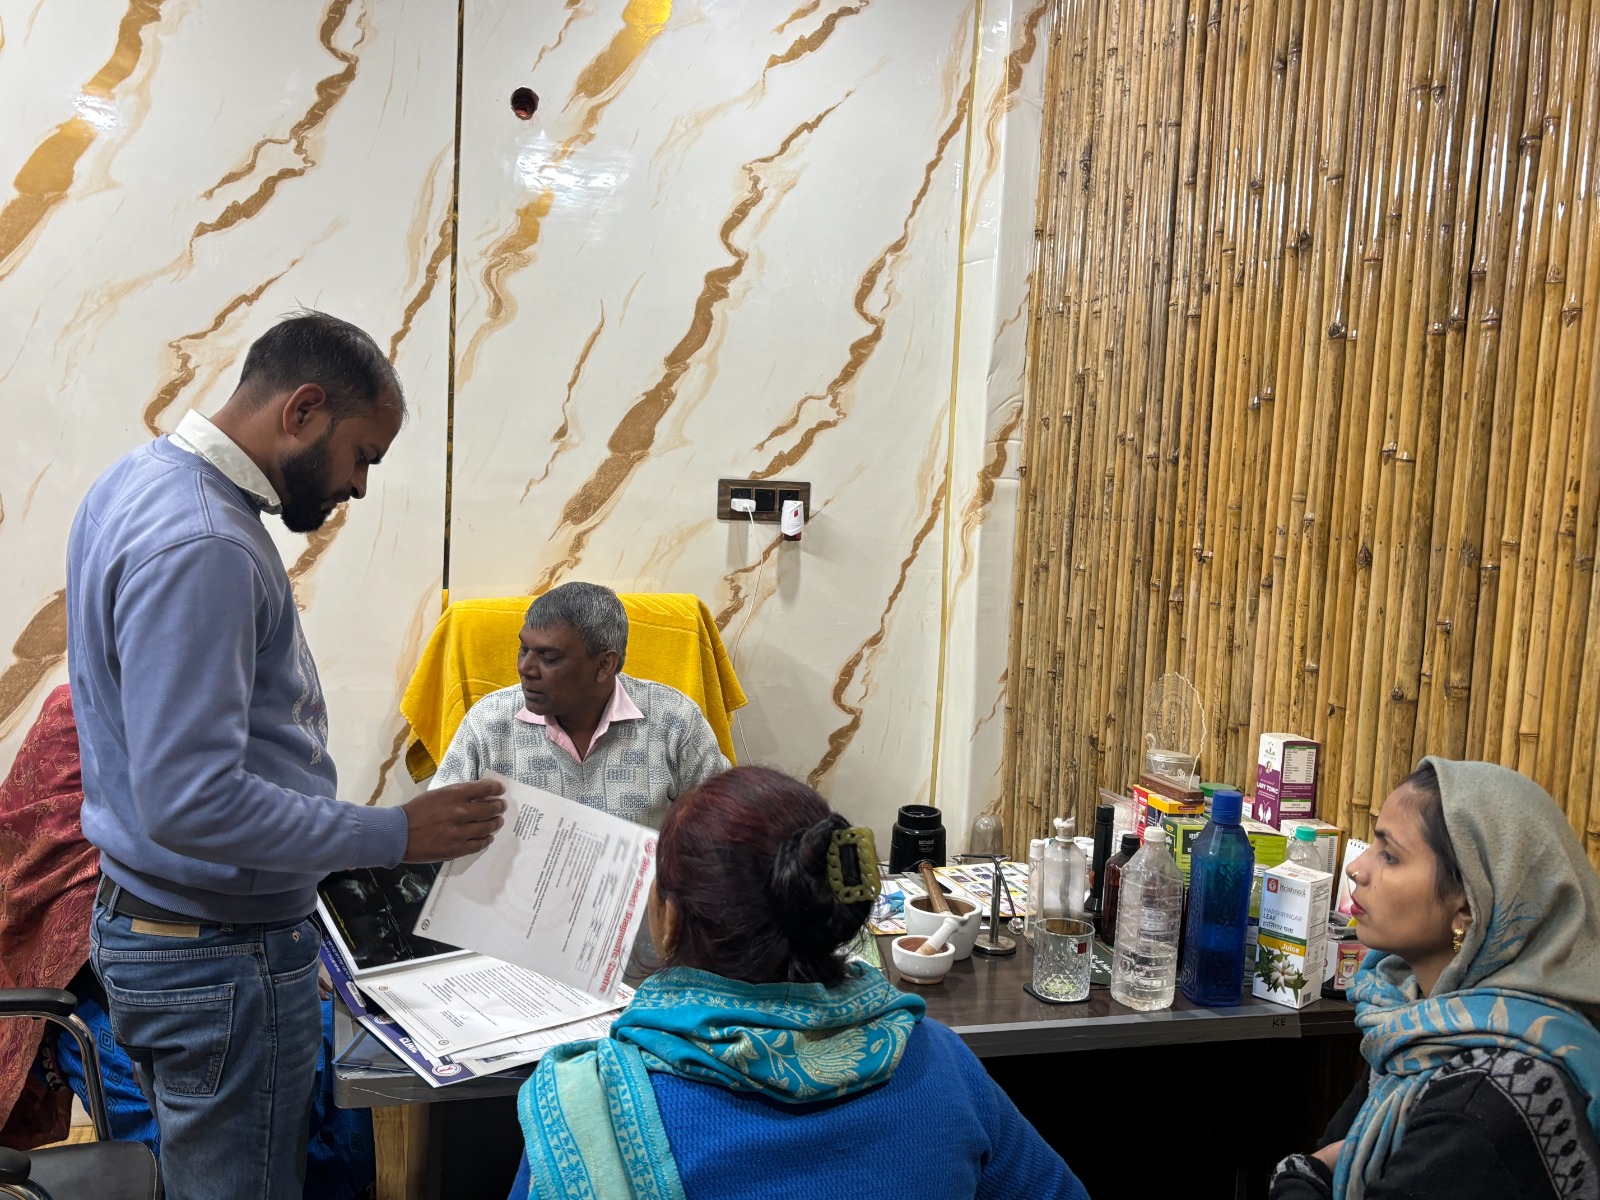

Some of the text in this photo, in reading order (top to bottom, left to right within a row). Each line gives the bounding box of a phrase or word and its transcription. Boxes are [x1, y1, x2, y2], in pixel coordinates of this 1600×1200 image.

[1256, 781, 1267, 790] LADY
[1266, 785, 1279, 795] TONIC
[1263, 913, 1276, 921] LEAF
[1281, 943, 1300, 954] Juice
[1272, 1017, 1287, 1028] KE
